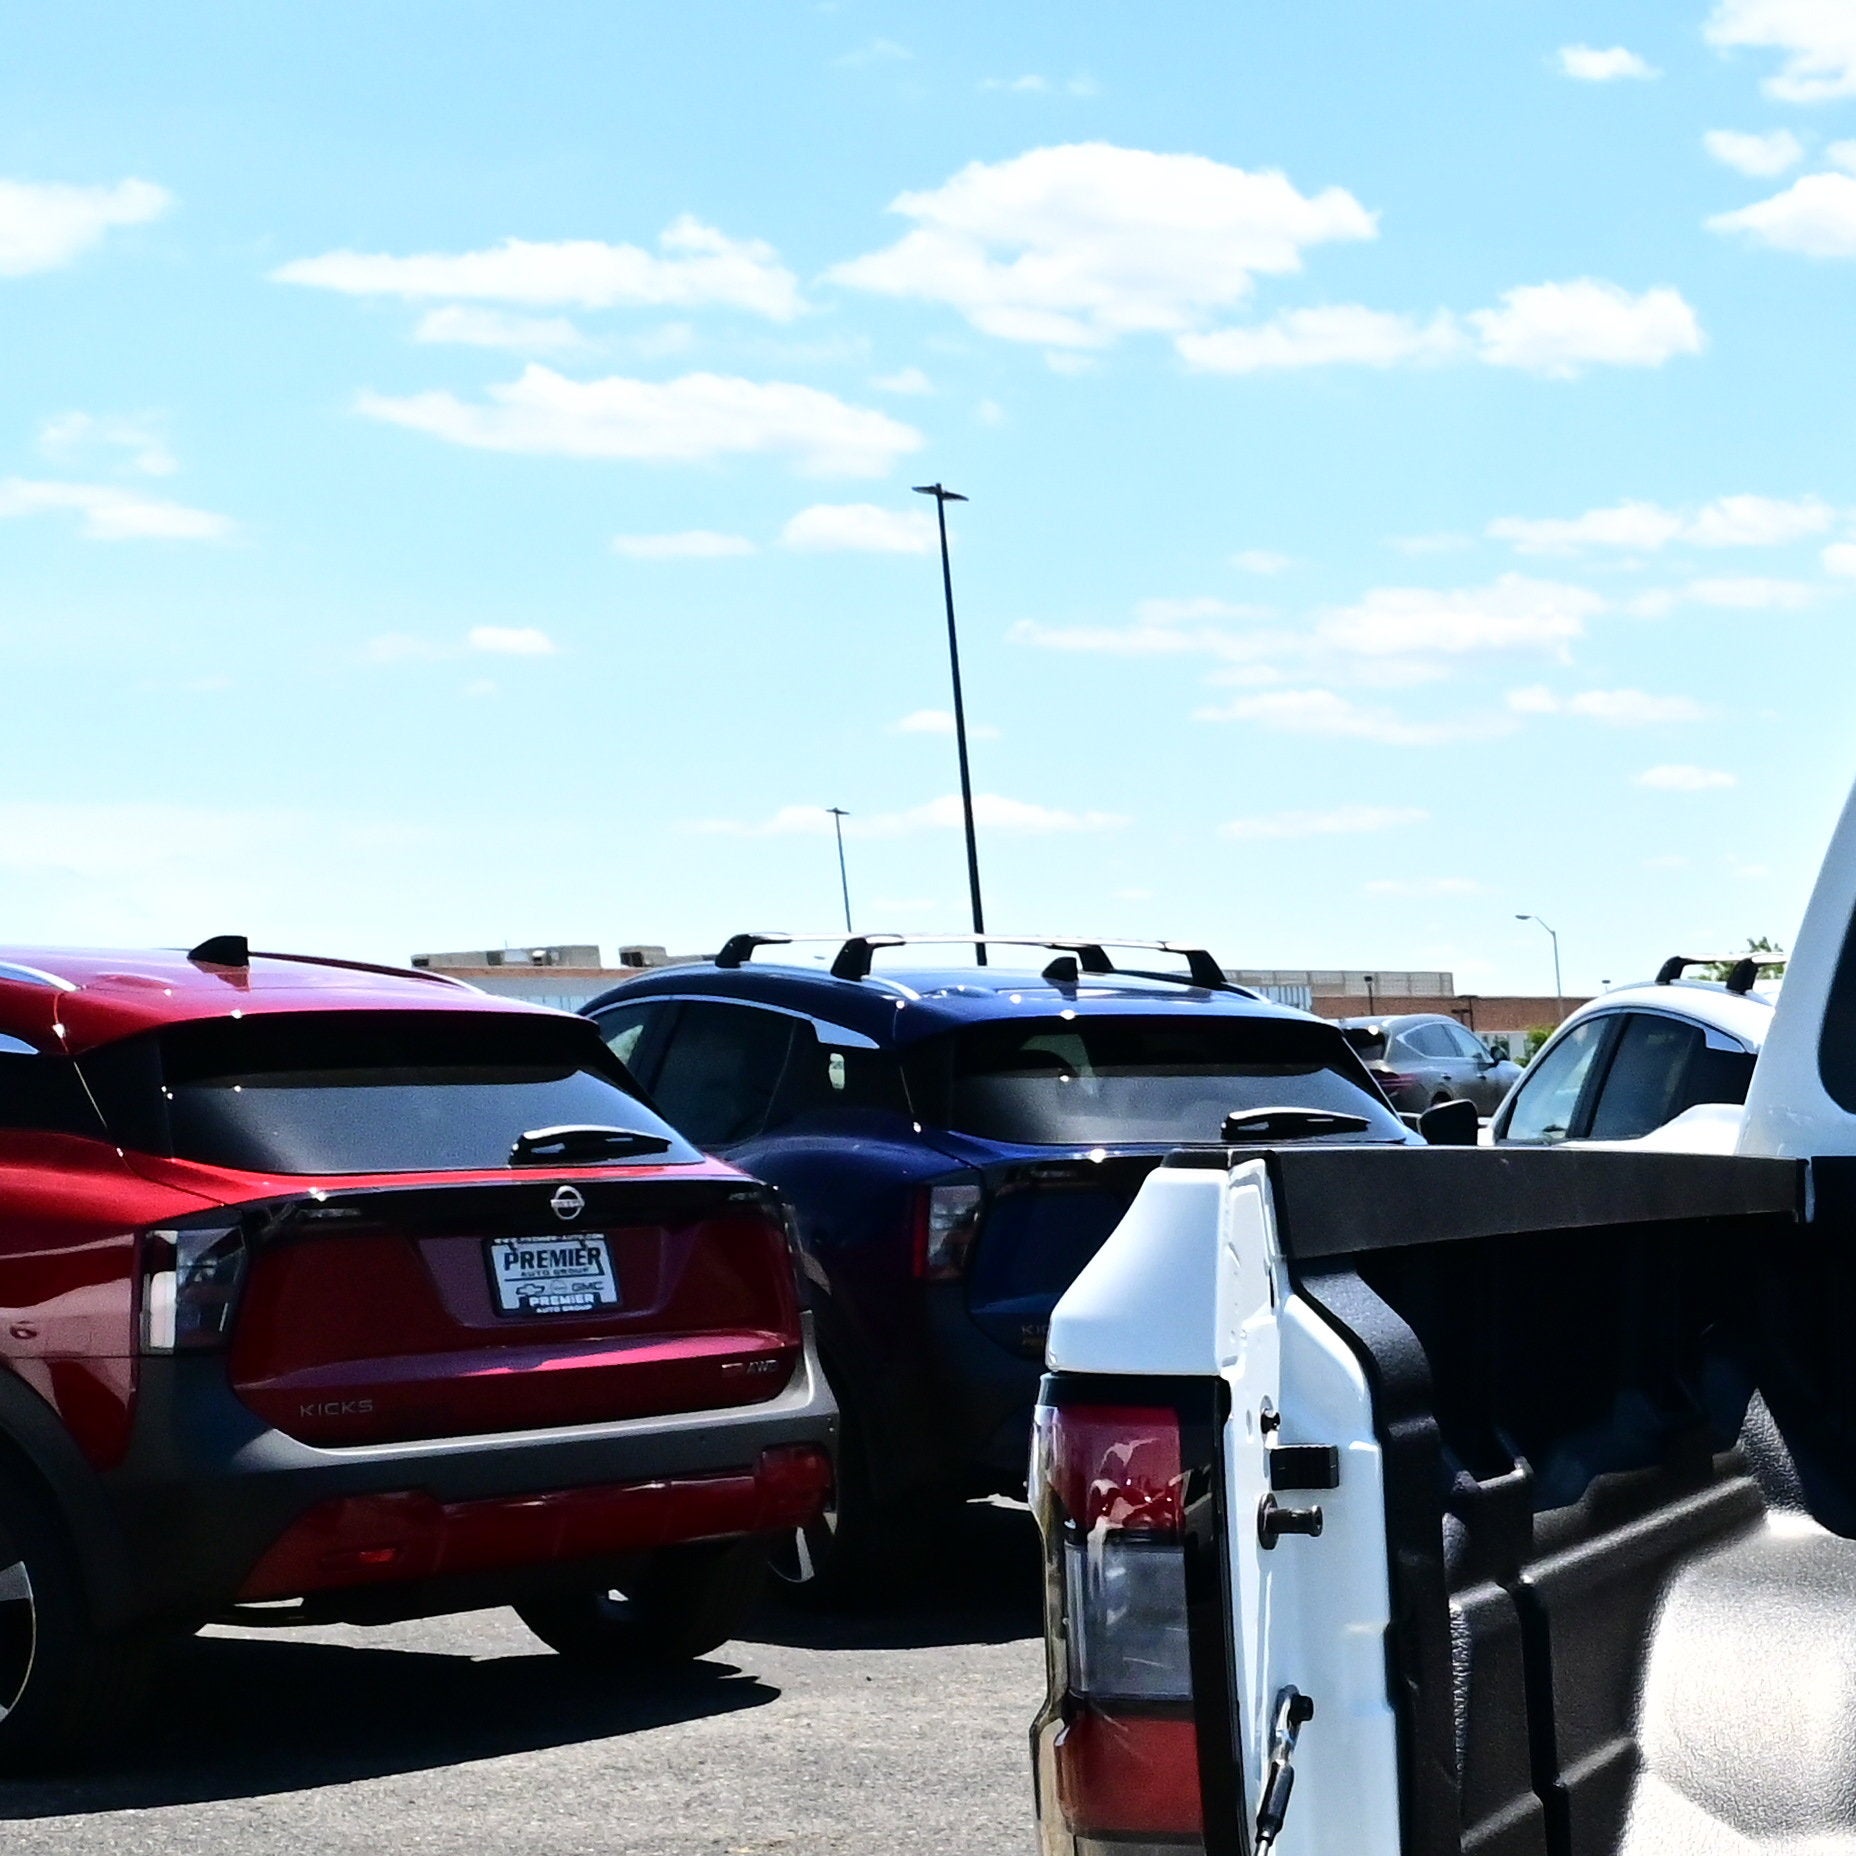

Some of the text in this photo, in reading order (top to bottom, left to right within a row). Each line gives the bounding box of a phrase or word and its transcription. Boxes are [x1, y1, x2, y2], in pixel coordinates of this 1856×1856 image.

[504, 1247, 605, 1273] PREMIER
[571, 1281, 604, 1292] GMC
[529, 1294, 595, 1307] PREMIER
[300, 1400, 374, 1417] KICKS
